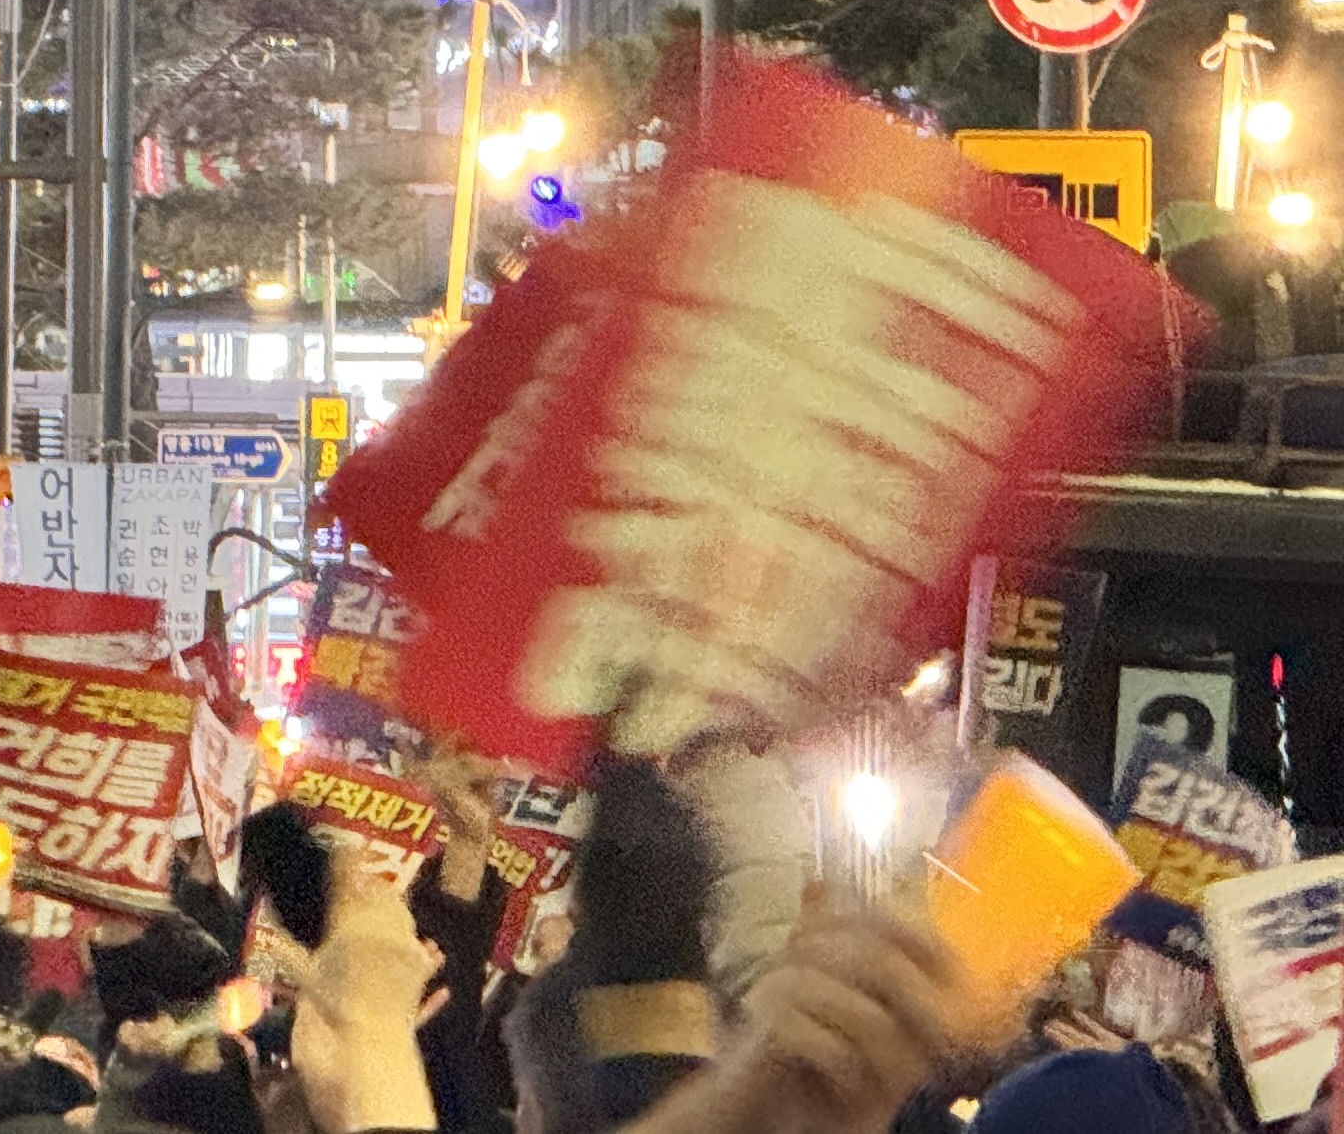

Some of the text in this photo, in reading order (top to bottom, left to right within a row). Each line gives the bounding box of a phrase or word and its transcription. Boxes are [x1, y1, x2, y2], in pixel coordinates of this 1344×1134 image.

[321, 440, 338, 465] 8
[120, 466, 205, 485] URBAN
[119, 487, 203, 504] ZAKAPA
[39, 466, 80, 591] 어반자
[290, 769, 437, 843] 정적제거
